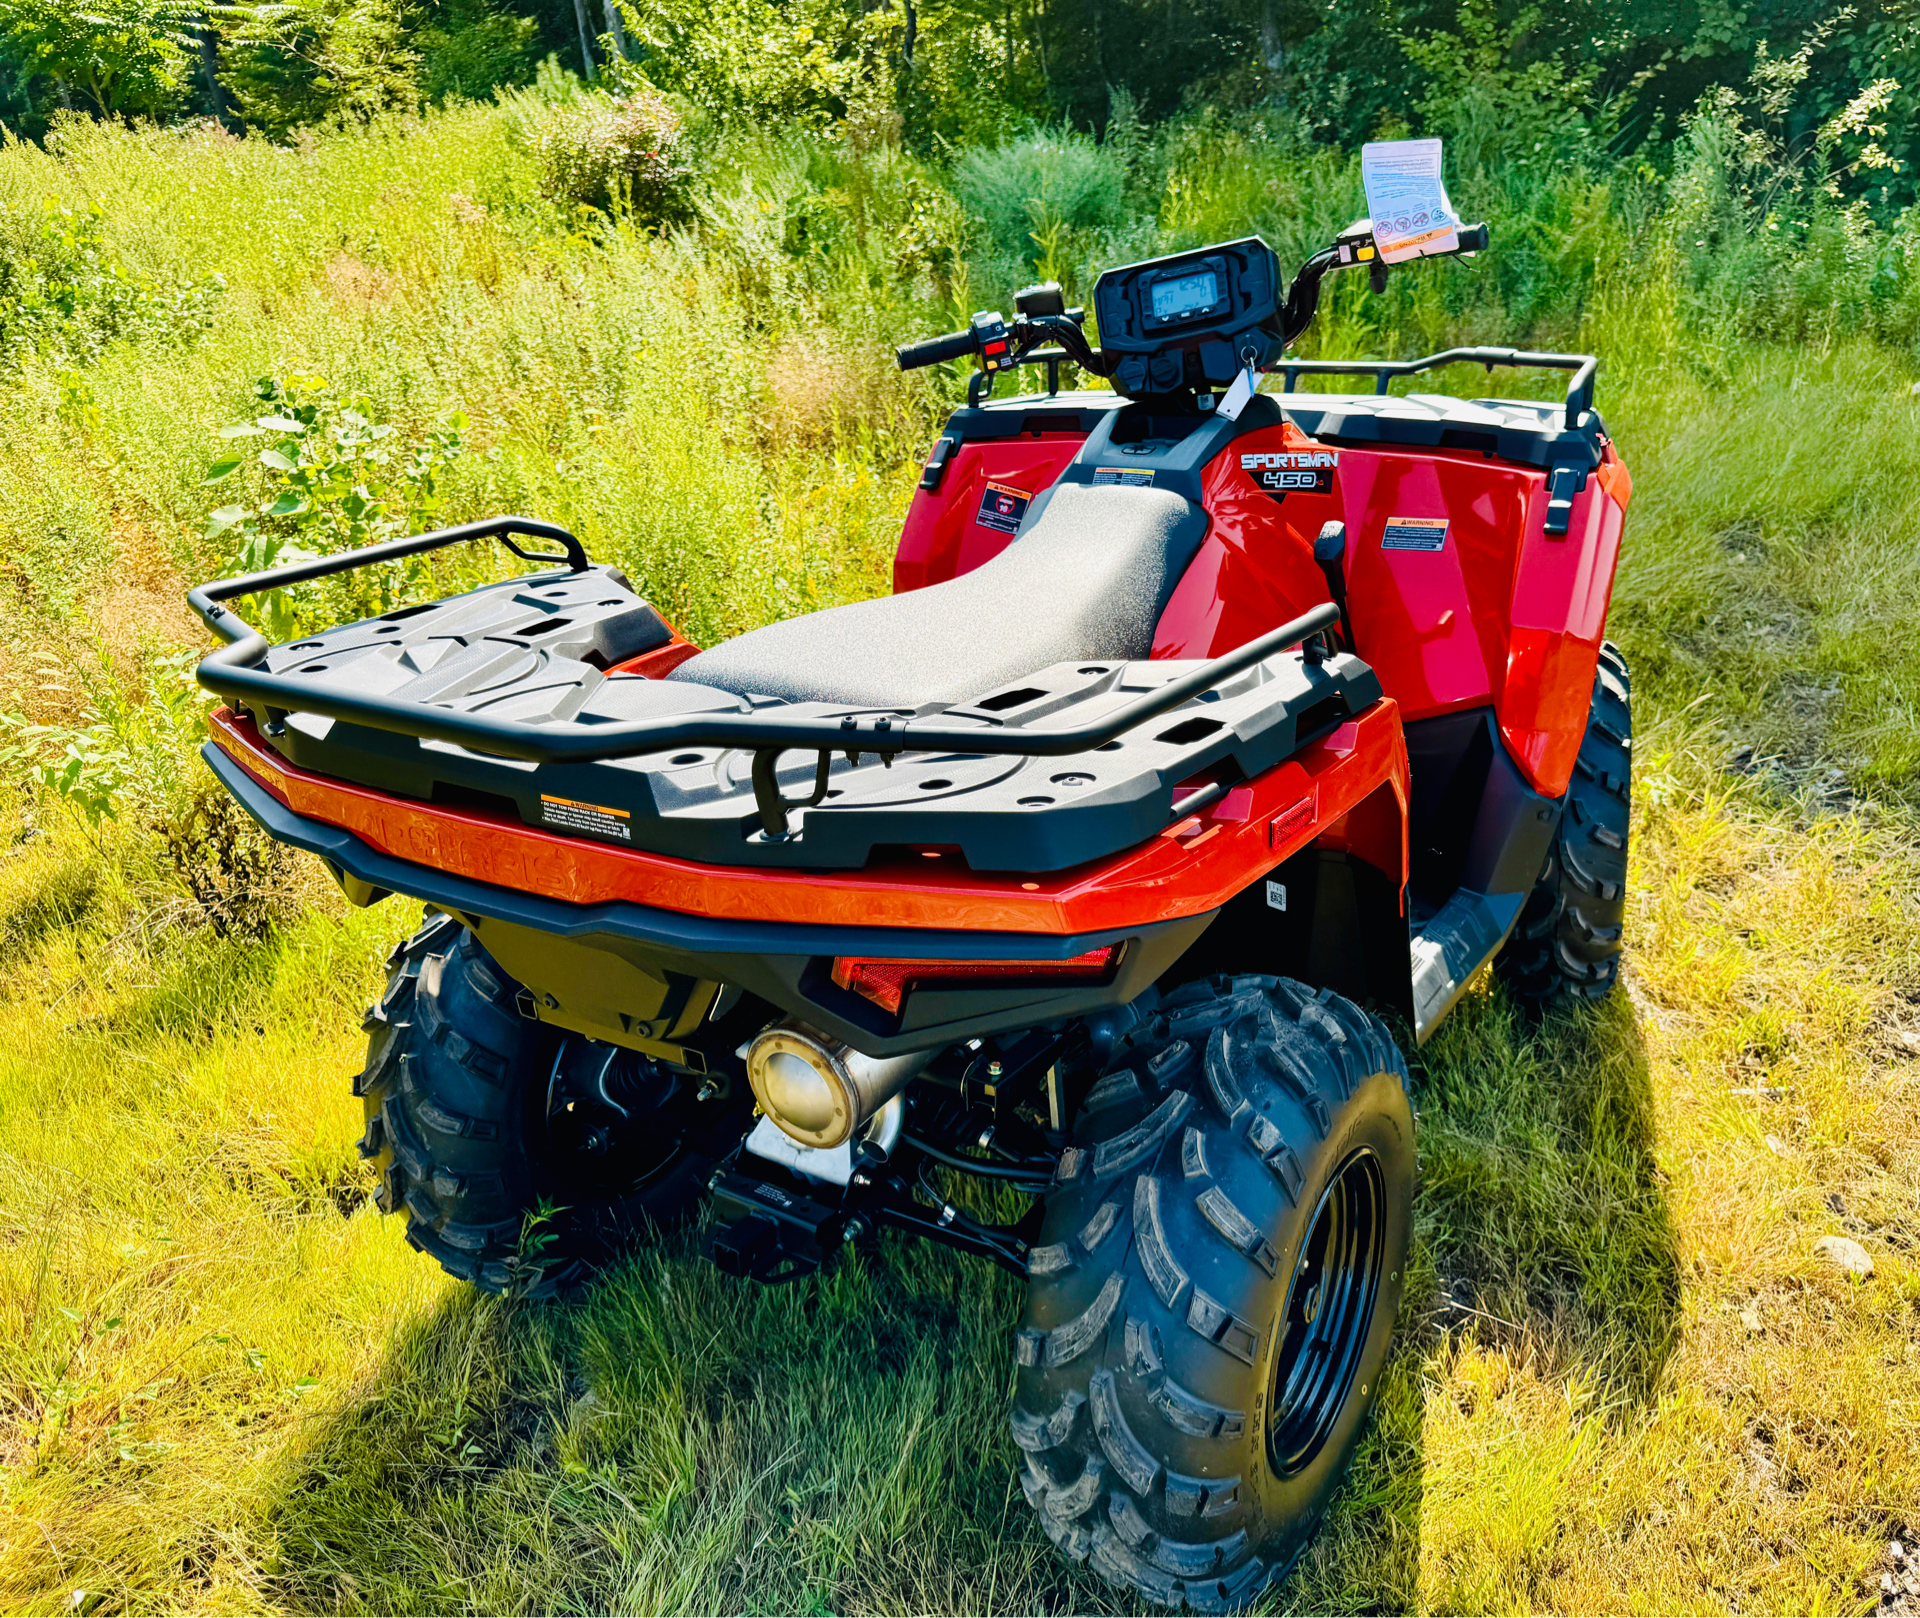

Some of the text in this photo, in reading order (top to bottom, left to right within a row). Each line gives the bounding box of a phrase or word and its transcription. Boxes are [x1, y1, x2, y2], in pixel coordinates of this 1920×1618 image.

[1241, 452, 1339, 470] SPORTSMAN
[1263, 472, 1317, 488] 450
[576, 802, 598, 811] WARNING
[380, 817, 564, 886] POLARIS
